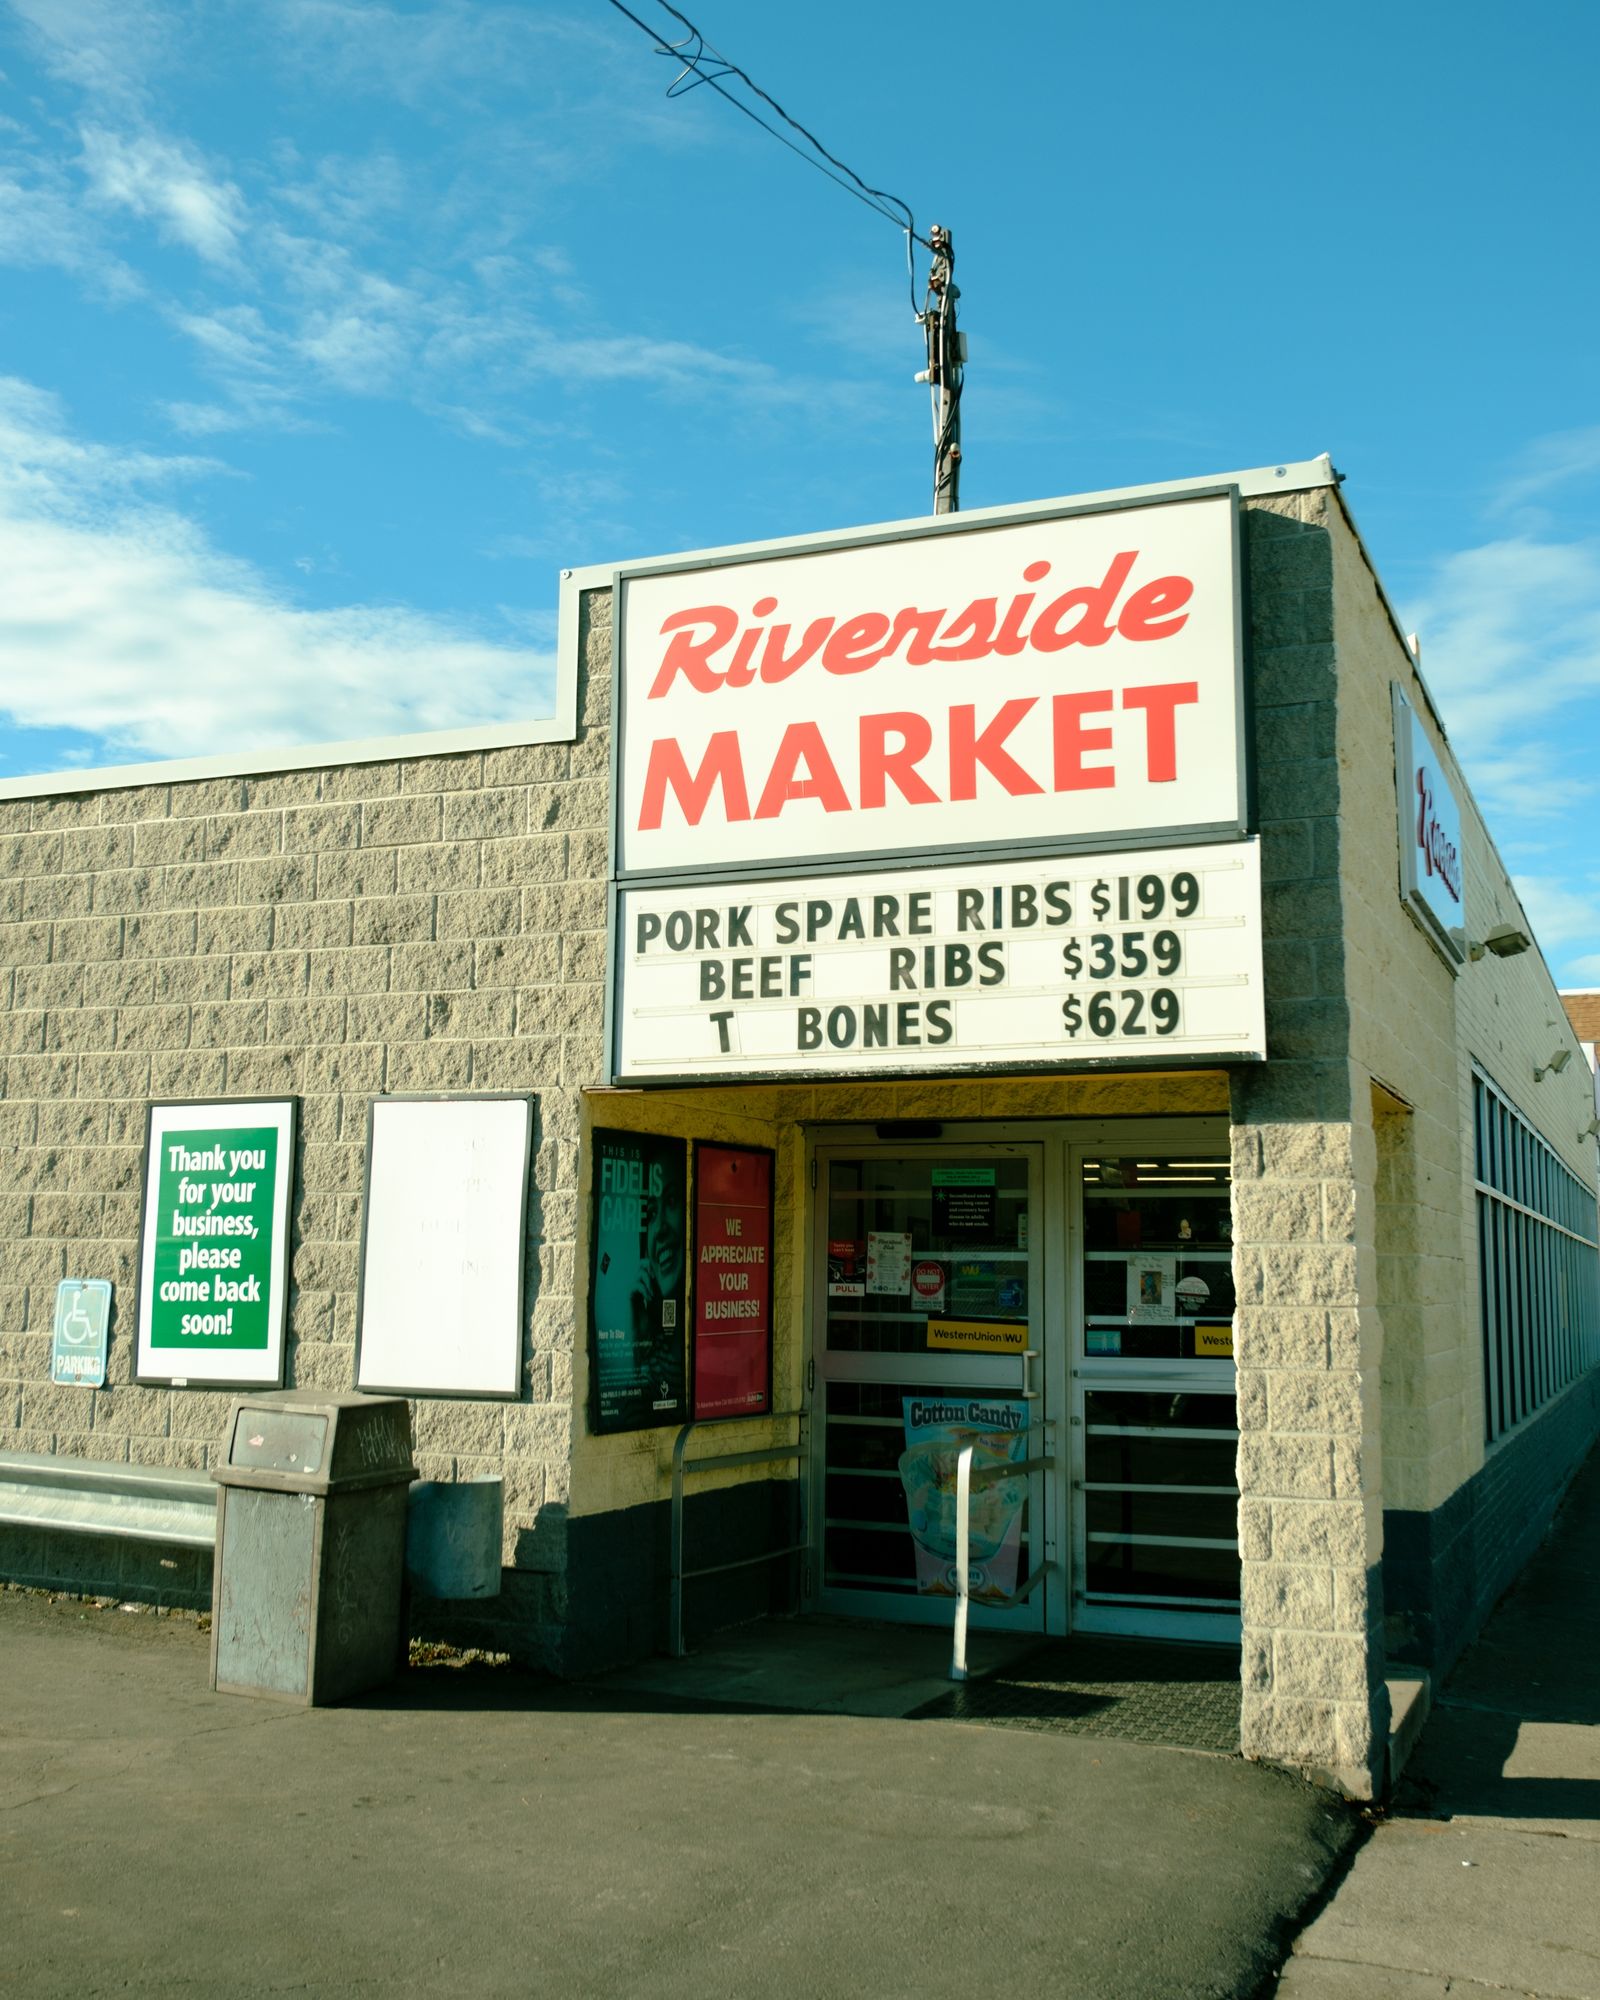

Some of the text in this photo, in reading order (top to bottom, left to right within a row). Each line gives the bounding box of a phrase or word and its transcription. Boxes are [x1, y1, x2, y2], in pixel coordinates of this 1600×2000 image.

[648, 550, 1196, 700] Riverside
[637, 681, 1200, 832] MARKET
[637, 871, 1199, 954] PORK SPARE RIBS $199
[700, 930, 1182, 1001] BEEF RIBS $359
[709, 988, 1181, 1053] T BONES $629
[169, 1144, 266, 1177] Thank you
[602, 1145, 641, 1159] THIS IS
[601, 1157, 663, 1197] FIDELIS
[178, 1177, 256, 1210] for your
[172, 1209, 259, 1240] business,
[601, 1195, 648, 1233] CARE
[726, 1219, 742, 1236] WE
[179, 1242, 242, 1276] please
[701, 1246, 765, 1263] APPRECIATE
[160, 1274, 261, 1302] come back
[719, 1273, 748, 1291] YOUR
[835, 1285, 858, 1293] PULL
[181, 1308, 233, 1335] soon!
[705, 1299, 760, 1319] BUSINESS!
[56, 1355, 101, 1376] PARKING
[911, 1402, 1022, 1430] Cotton Candy
